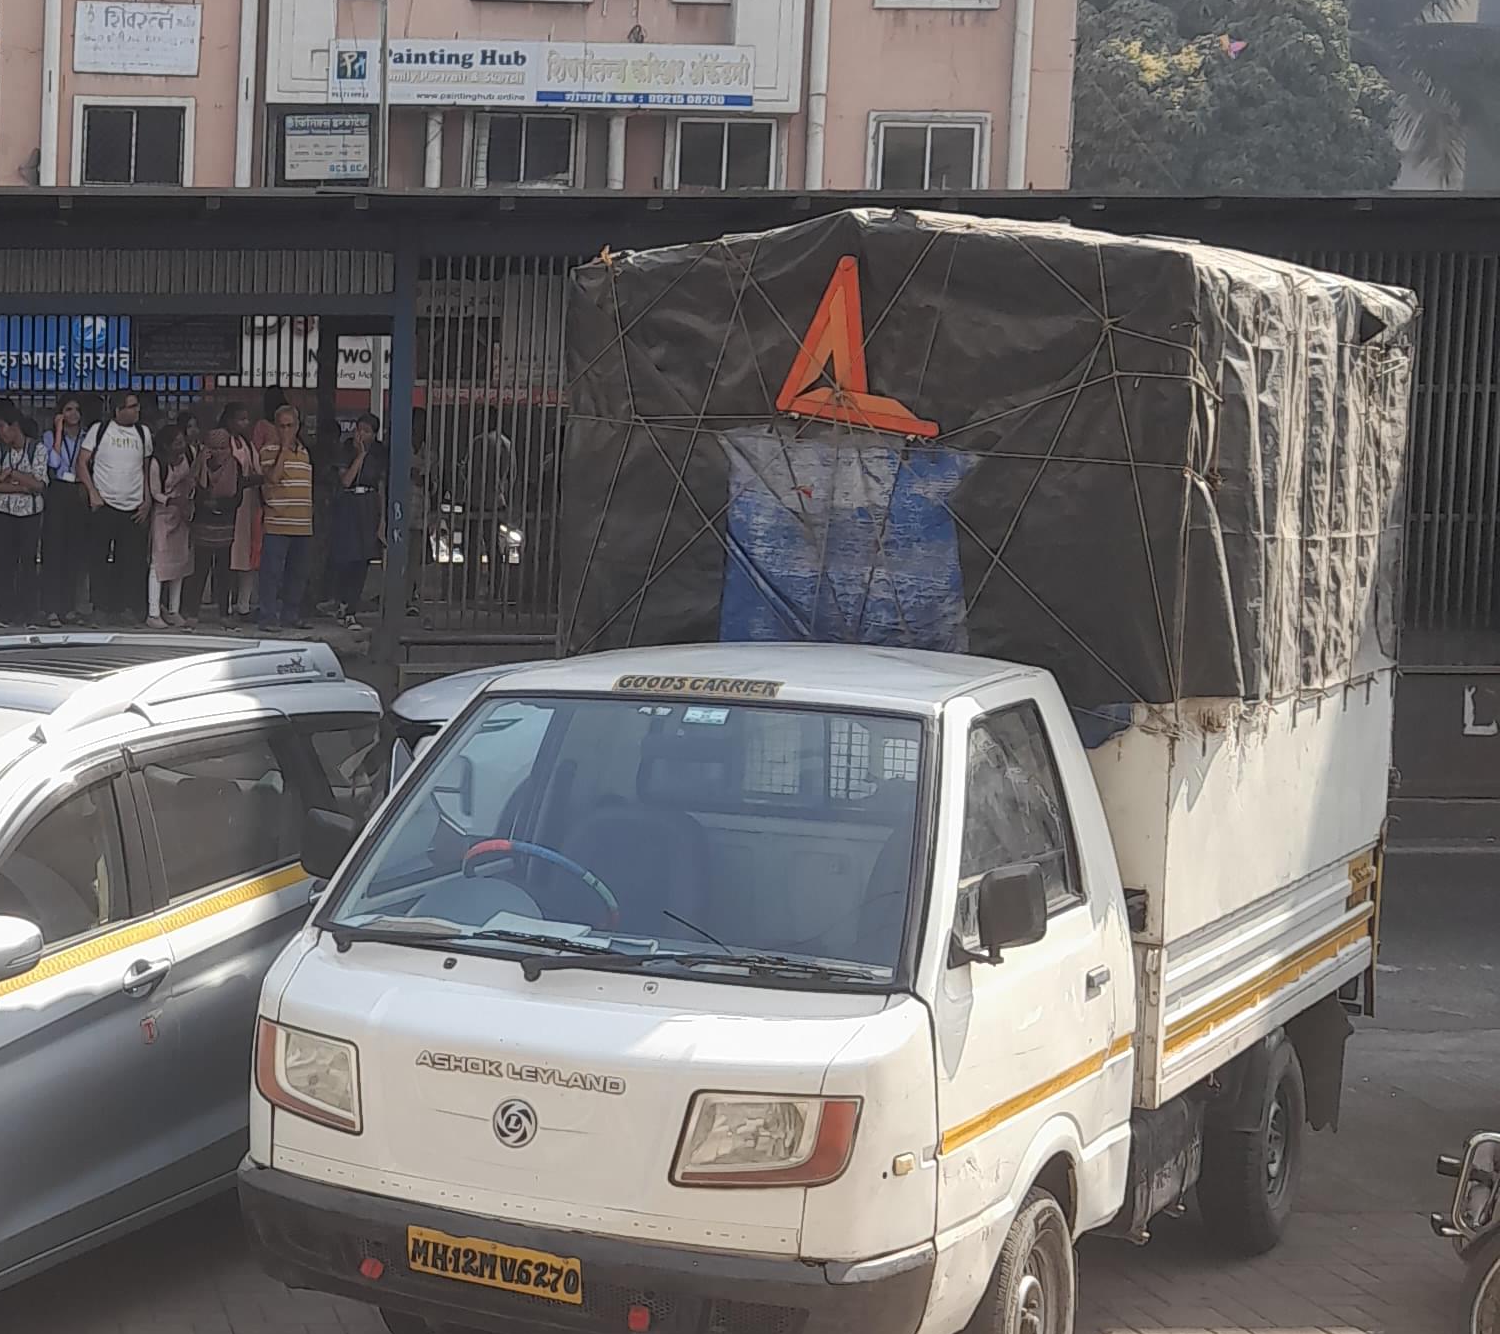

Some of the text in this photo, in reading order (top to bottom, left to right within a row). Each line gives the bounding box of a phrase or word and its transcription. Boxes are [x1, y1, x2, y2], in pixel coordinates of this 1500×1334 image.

[480, 49, 527, 66] Hub
[618, 675, 780, 698] GOODS CARRIER
[415, 1049, 626, 1095] ASHOK LEYLAND
